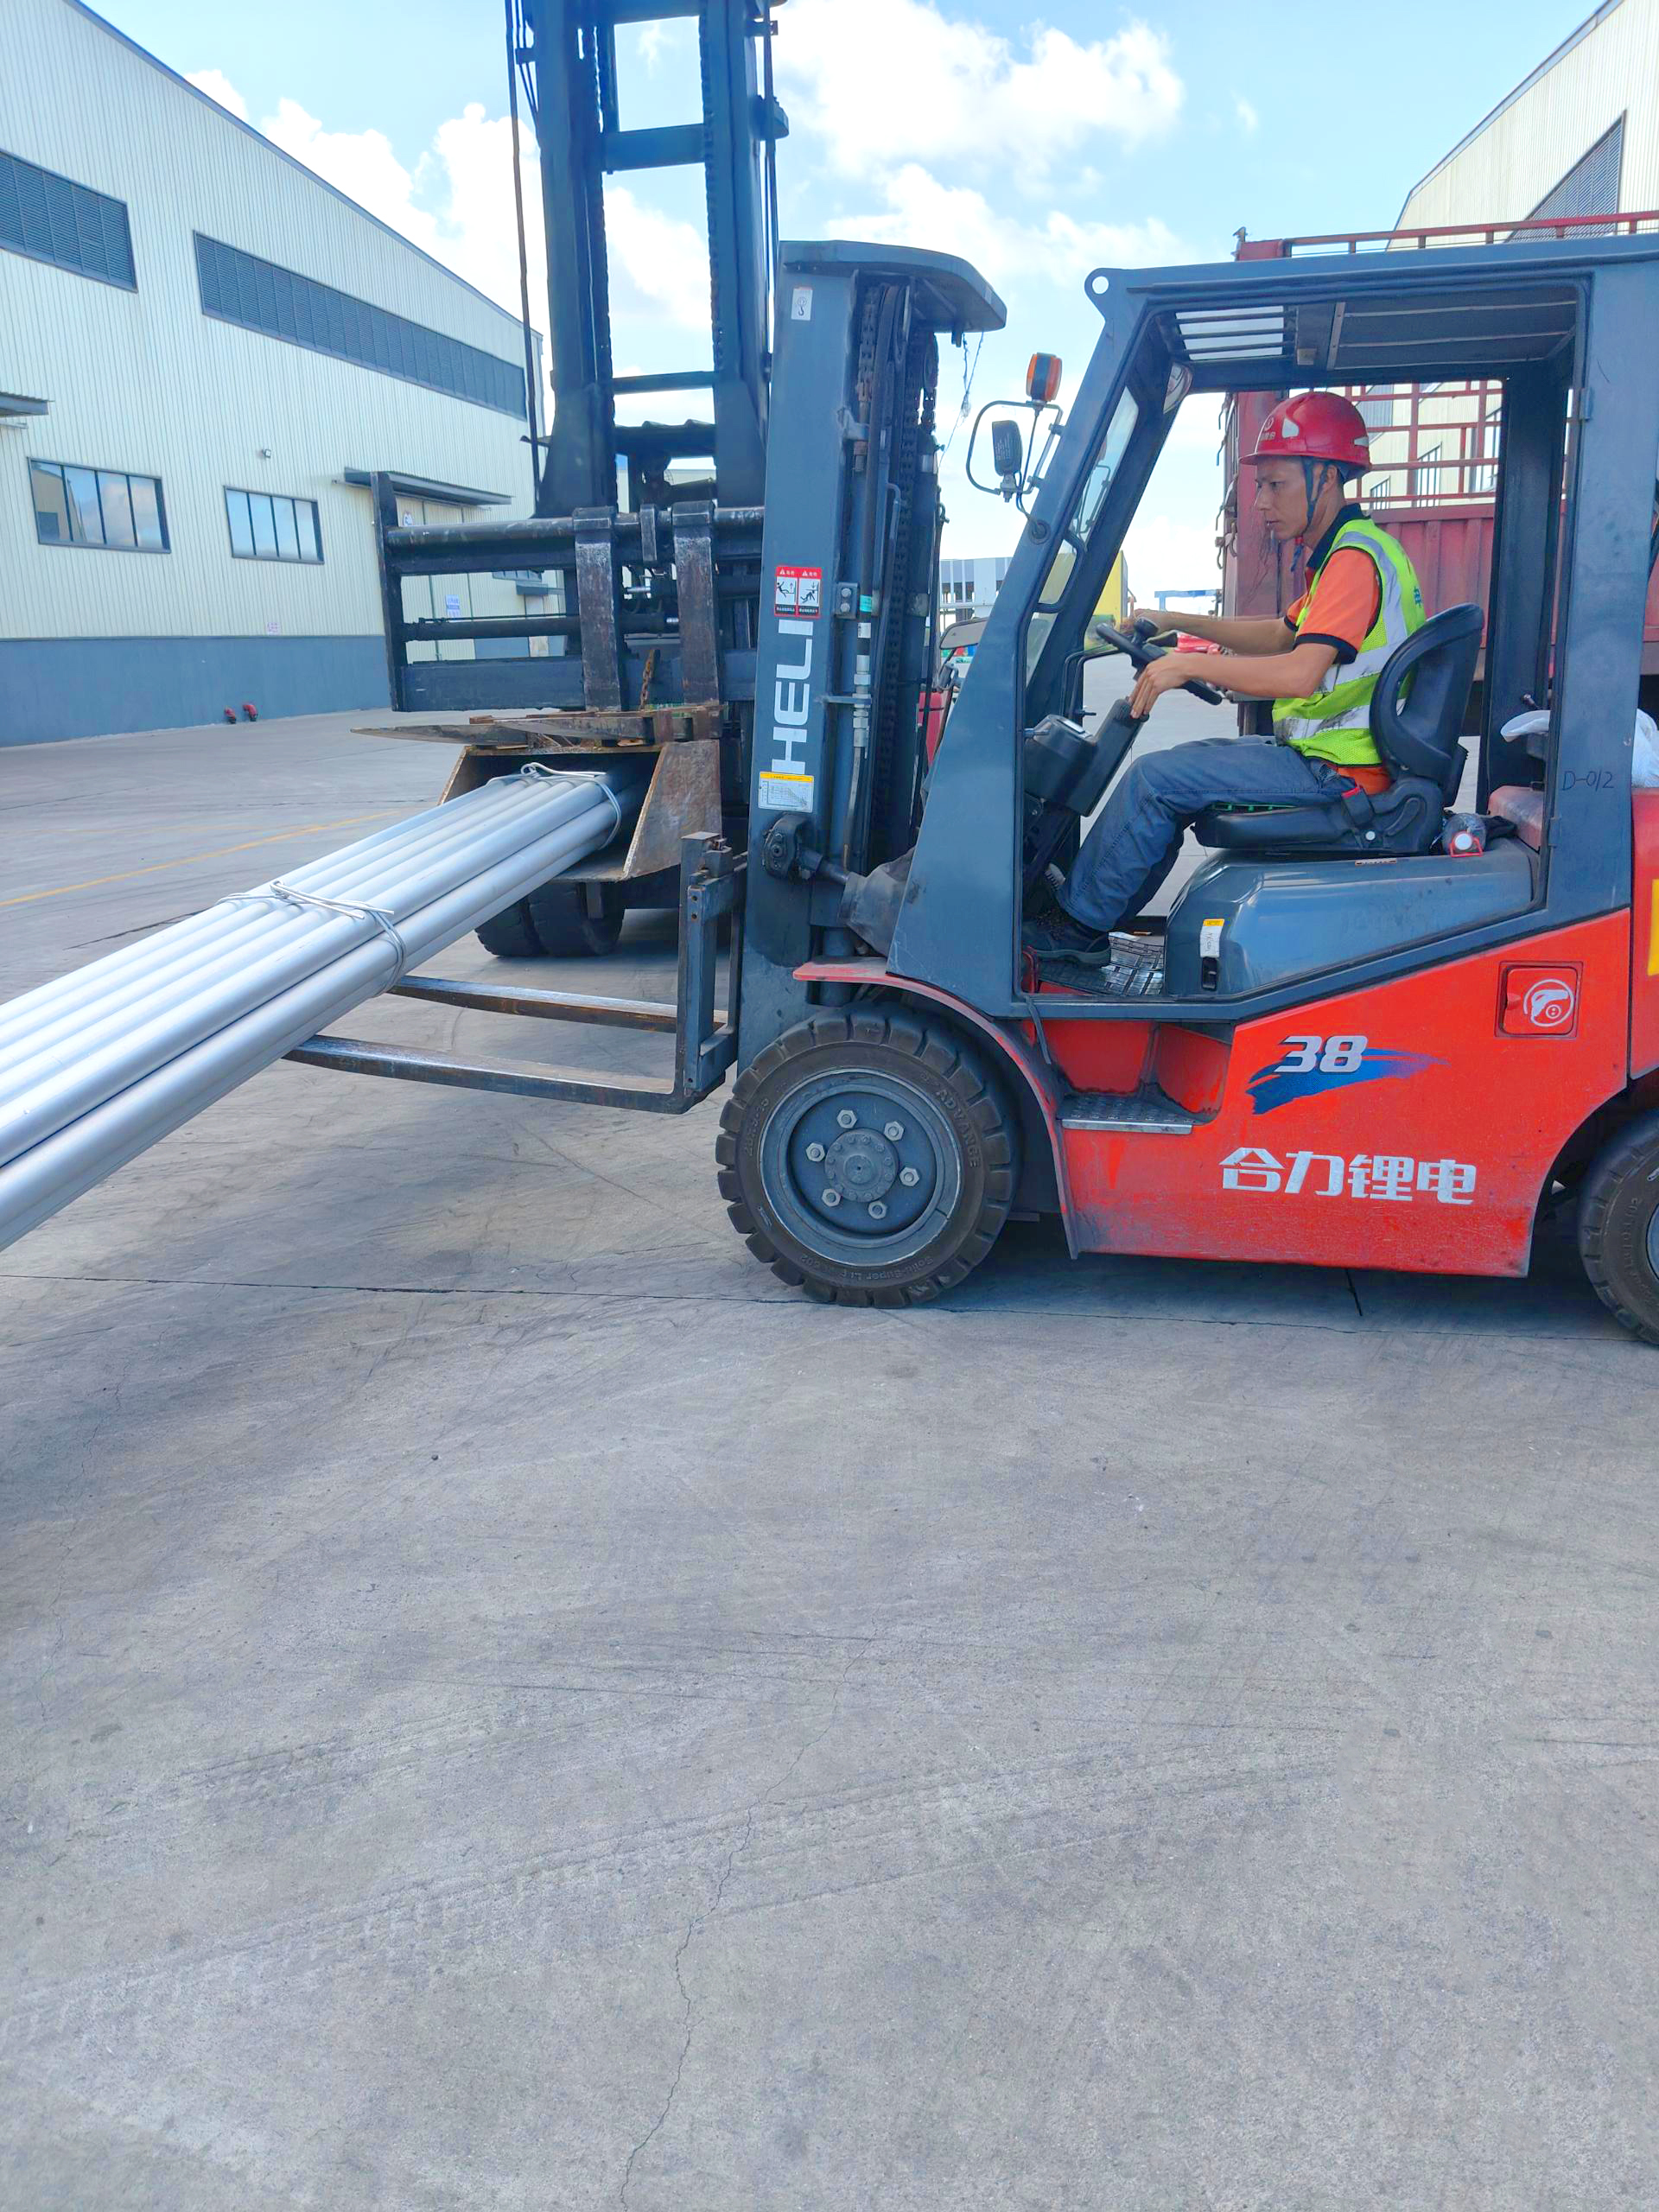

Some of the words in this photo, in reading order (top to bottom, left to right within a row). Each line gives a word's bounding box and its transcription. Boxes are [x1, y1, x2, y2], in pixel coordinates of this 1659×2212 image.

[771, 619, 814, 775] HELI
[1274, 1035, 1369, 1073] 38
[1218, 1147, 1478, 1206] 合力锂电
